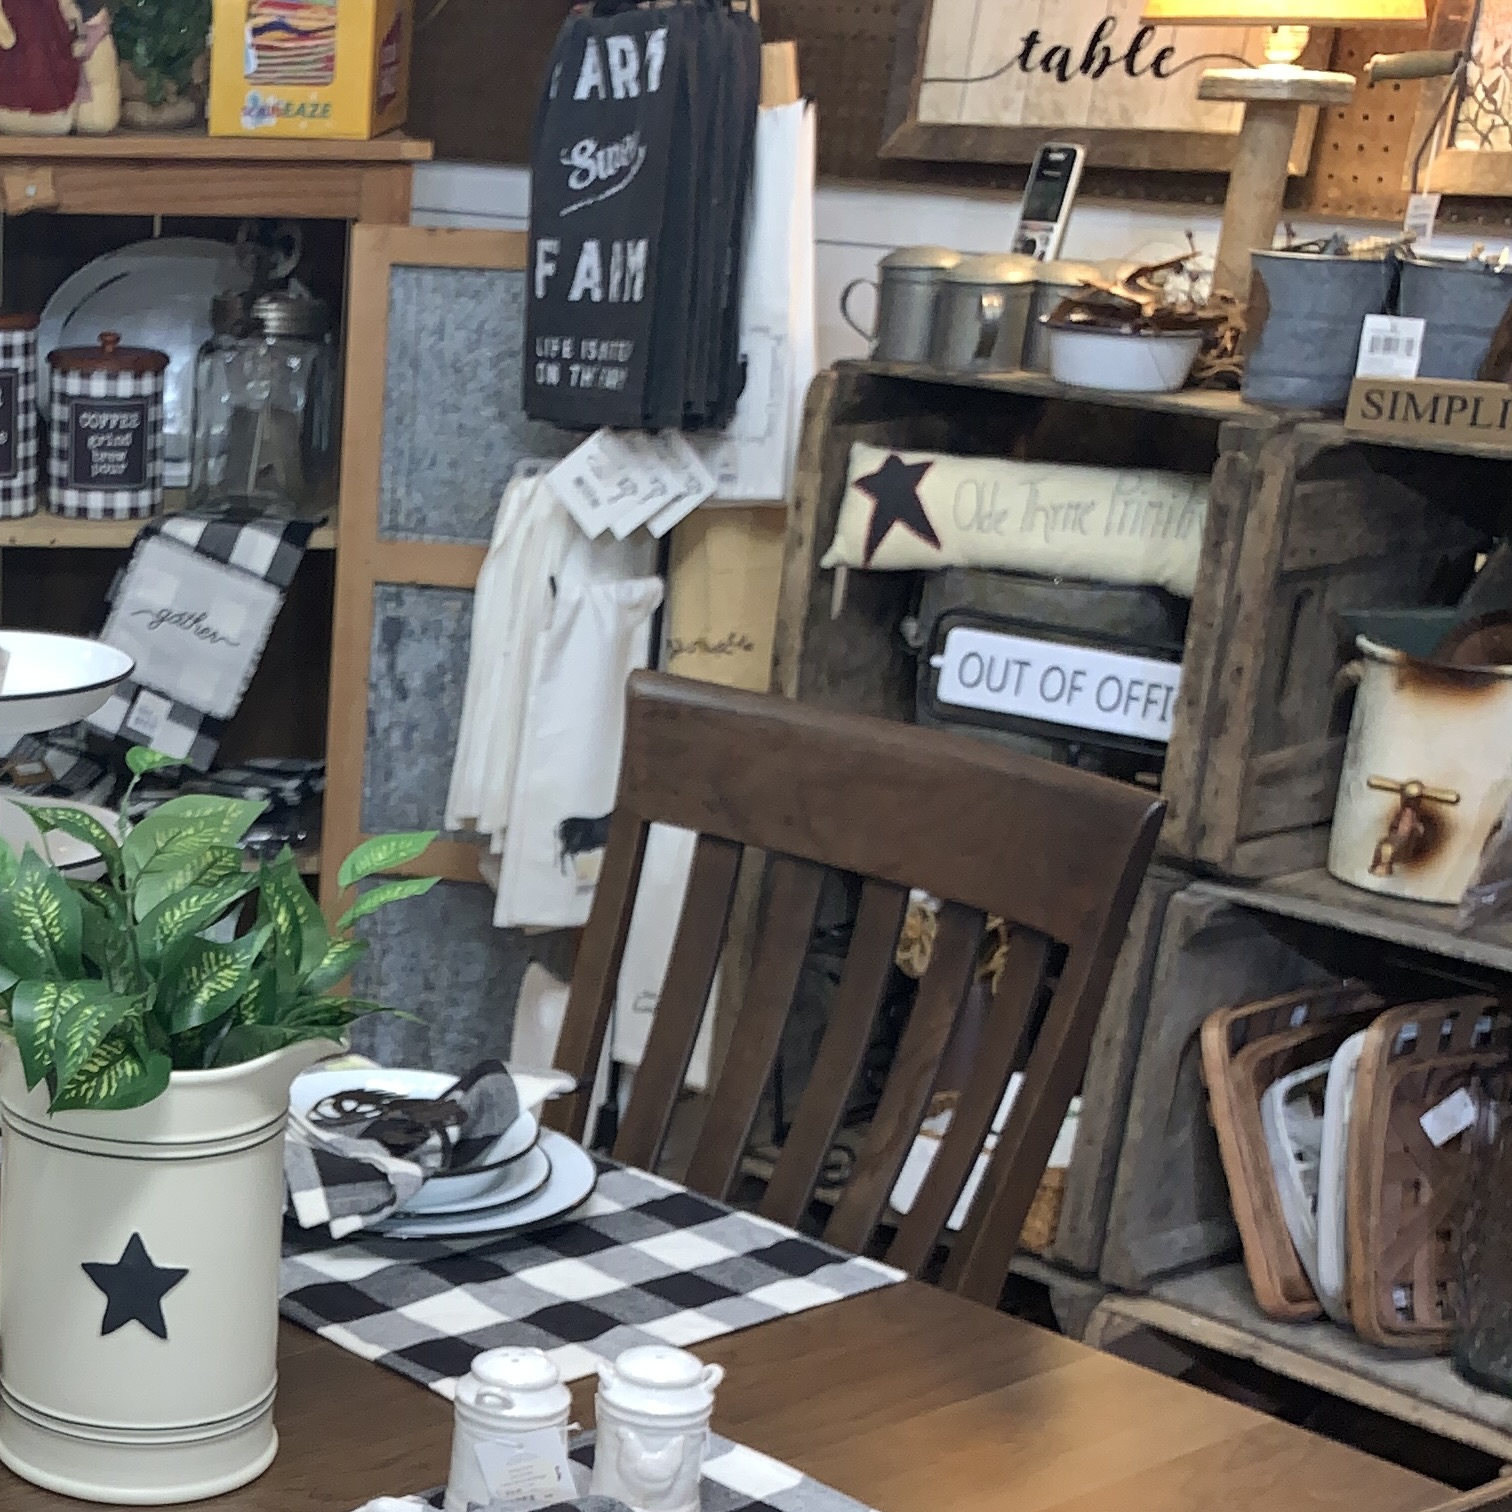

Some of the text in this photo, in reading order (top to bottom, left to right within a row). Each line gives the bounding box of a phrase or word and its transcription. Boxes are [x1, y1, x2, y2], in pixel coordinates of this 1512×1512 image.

[1014, 15, 1184, 84] table
[79, 411, 141, 430] COFFEE
[141, 608, 228, 646] gather
[956, 650, 1031, 697] OUT
[1039, 664, 1088, 706] OF
